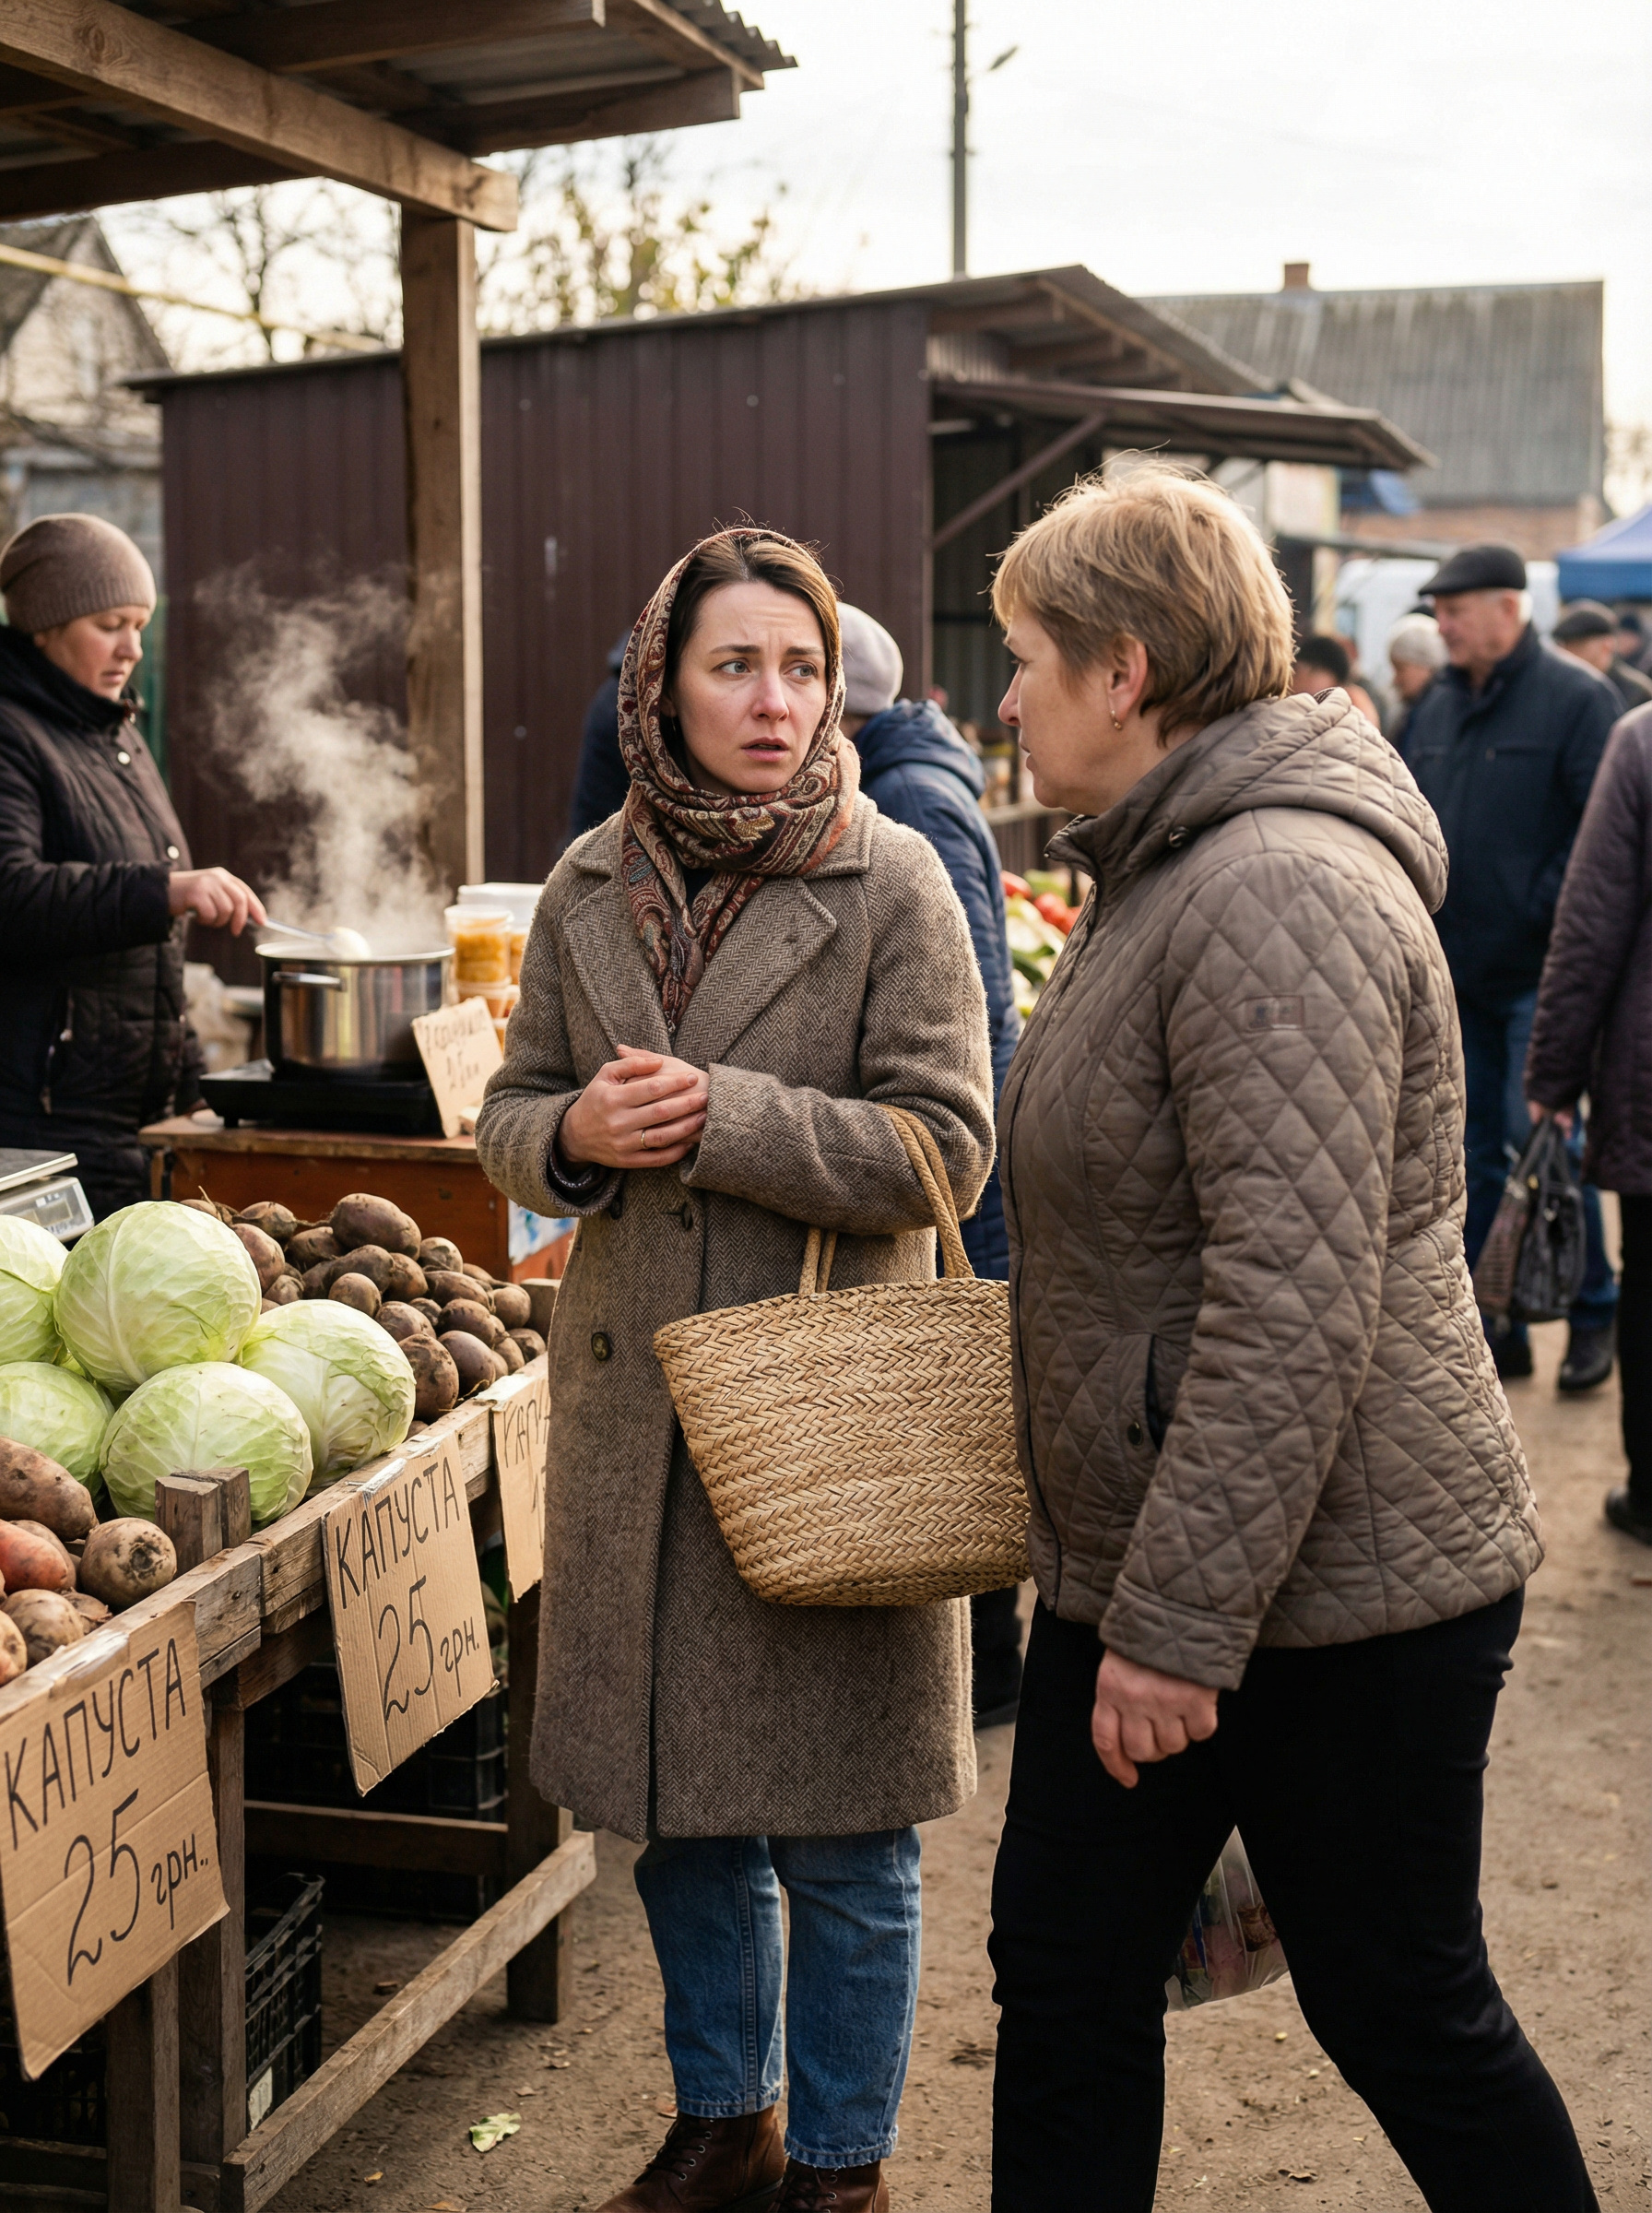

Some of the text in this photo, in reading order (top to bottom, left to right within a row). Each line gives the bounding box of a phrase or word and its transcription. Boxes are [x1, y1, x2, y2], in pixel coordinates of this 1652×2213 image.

[335, 1456, 461, 1610] КАПУСТА
[378, 1575, 480, 1722] 25 грн.
[5, 1638, 186, 1851] КАПУСТА
[64, 1788, 140, 1986] 25
